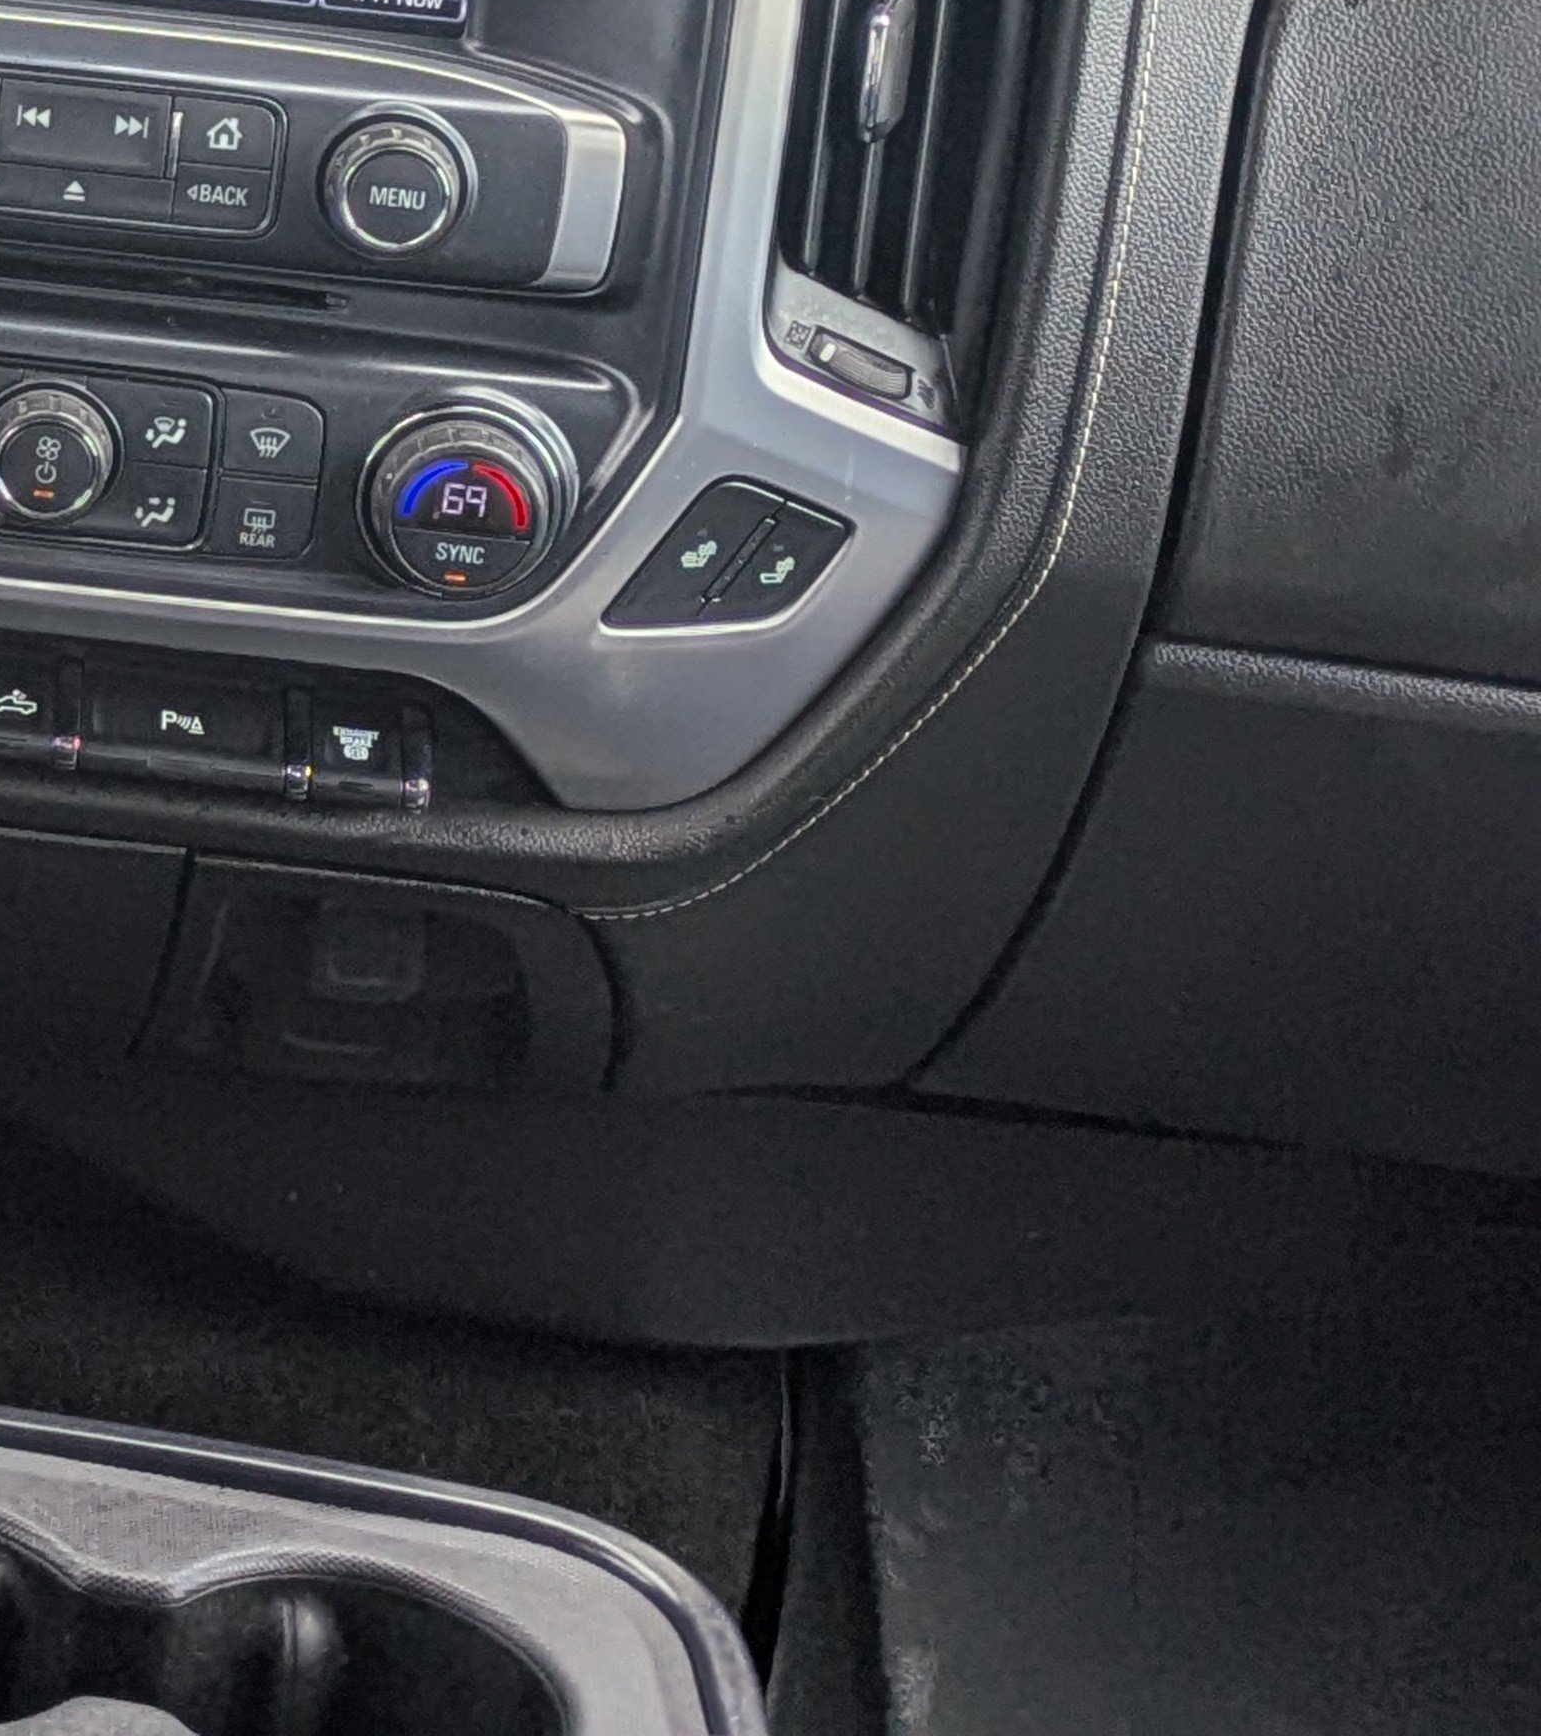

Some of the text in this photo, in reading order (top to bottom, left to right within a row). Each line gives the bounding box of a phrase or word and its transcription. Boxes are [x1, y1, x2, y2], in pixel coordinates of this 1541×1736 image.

[198, 182, 250, 209] BACK
[368, 185, 426, 211] MENU
[440, 482, 488, 519] 69
[239, 530, 276, 550] REAR
[435, 541, 486, 566] SYNC
